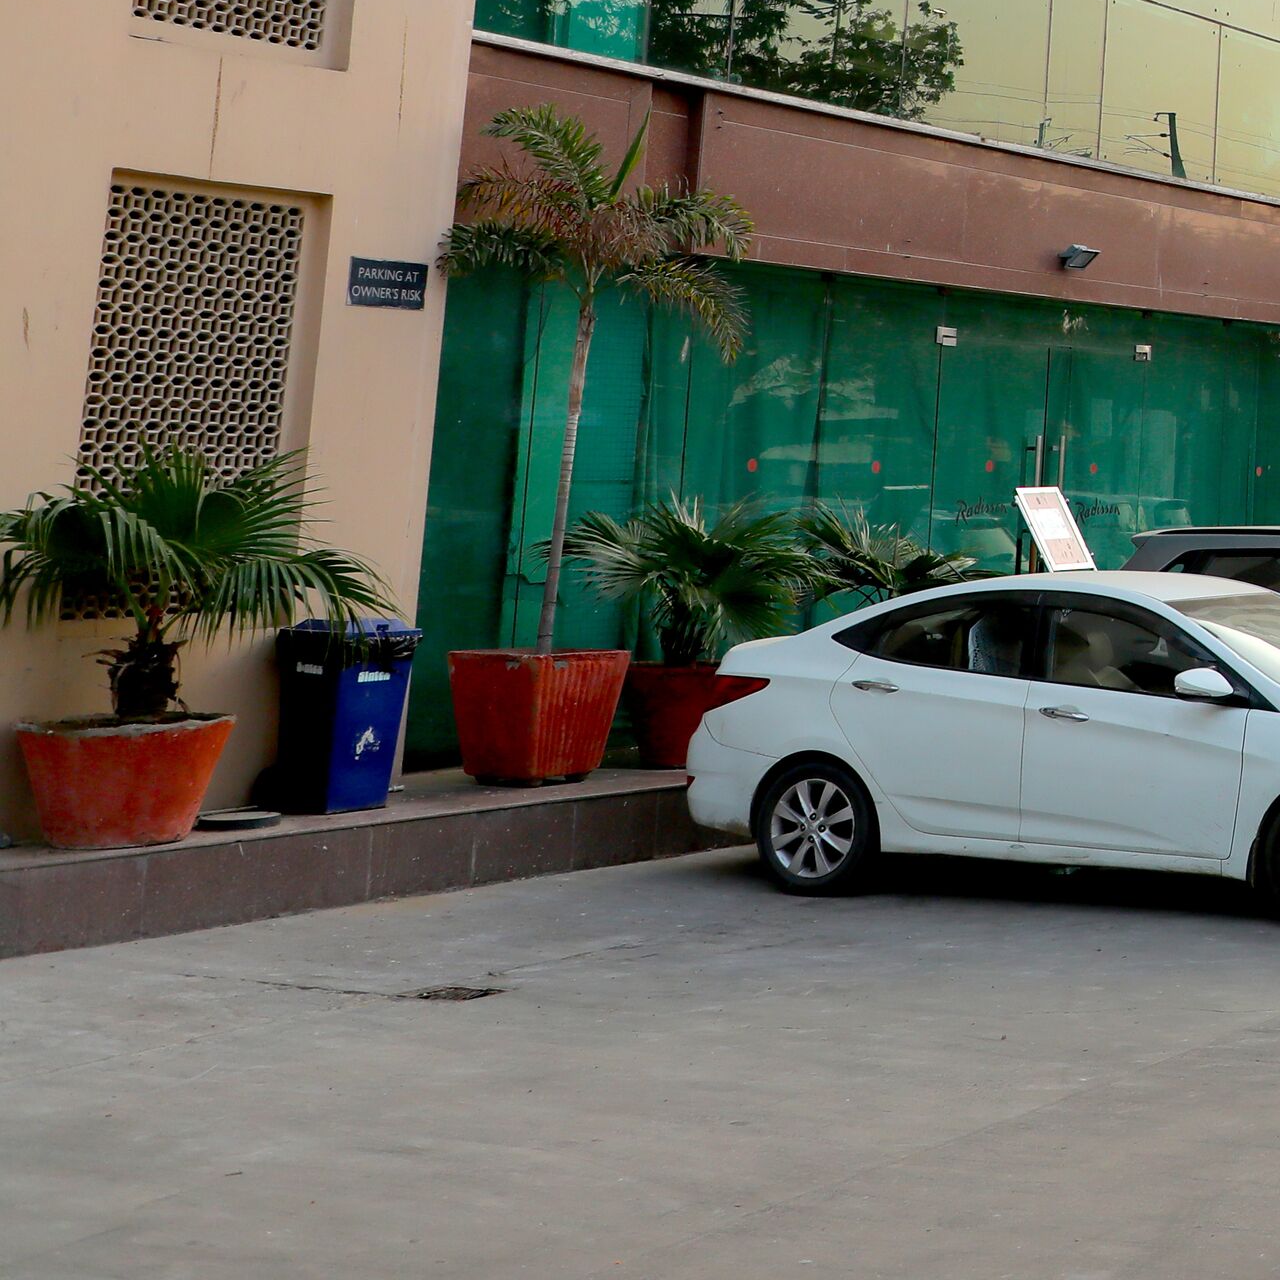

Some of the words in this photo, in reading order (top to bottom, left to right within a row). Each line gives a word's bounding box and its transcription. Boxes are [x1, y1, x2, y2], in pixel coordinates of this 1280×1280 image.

[358, 266, 403, 282] PARKING
[404, 271, 420, 283] AT
[351, 285, 399, 300] OWNER'S
[401, 288, 422, 301] RISK
